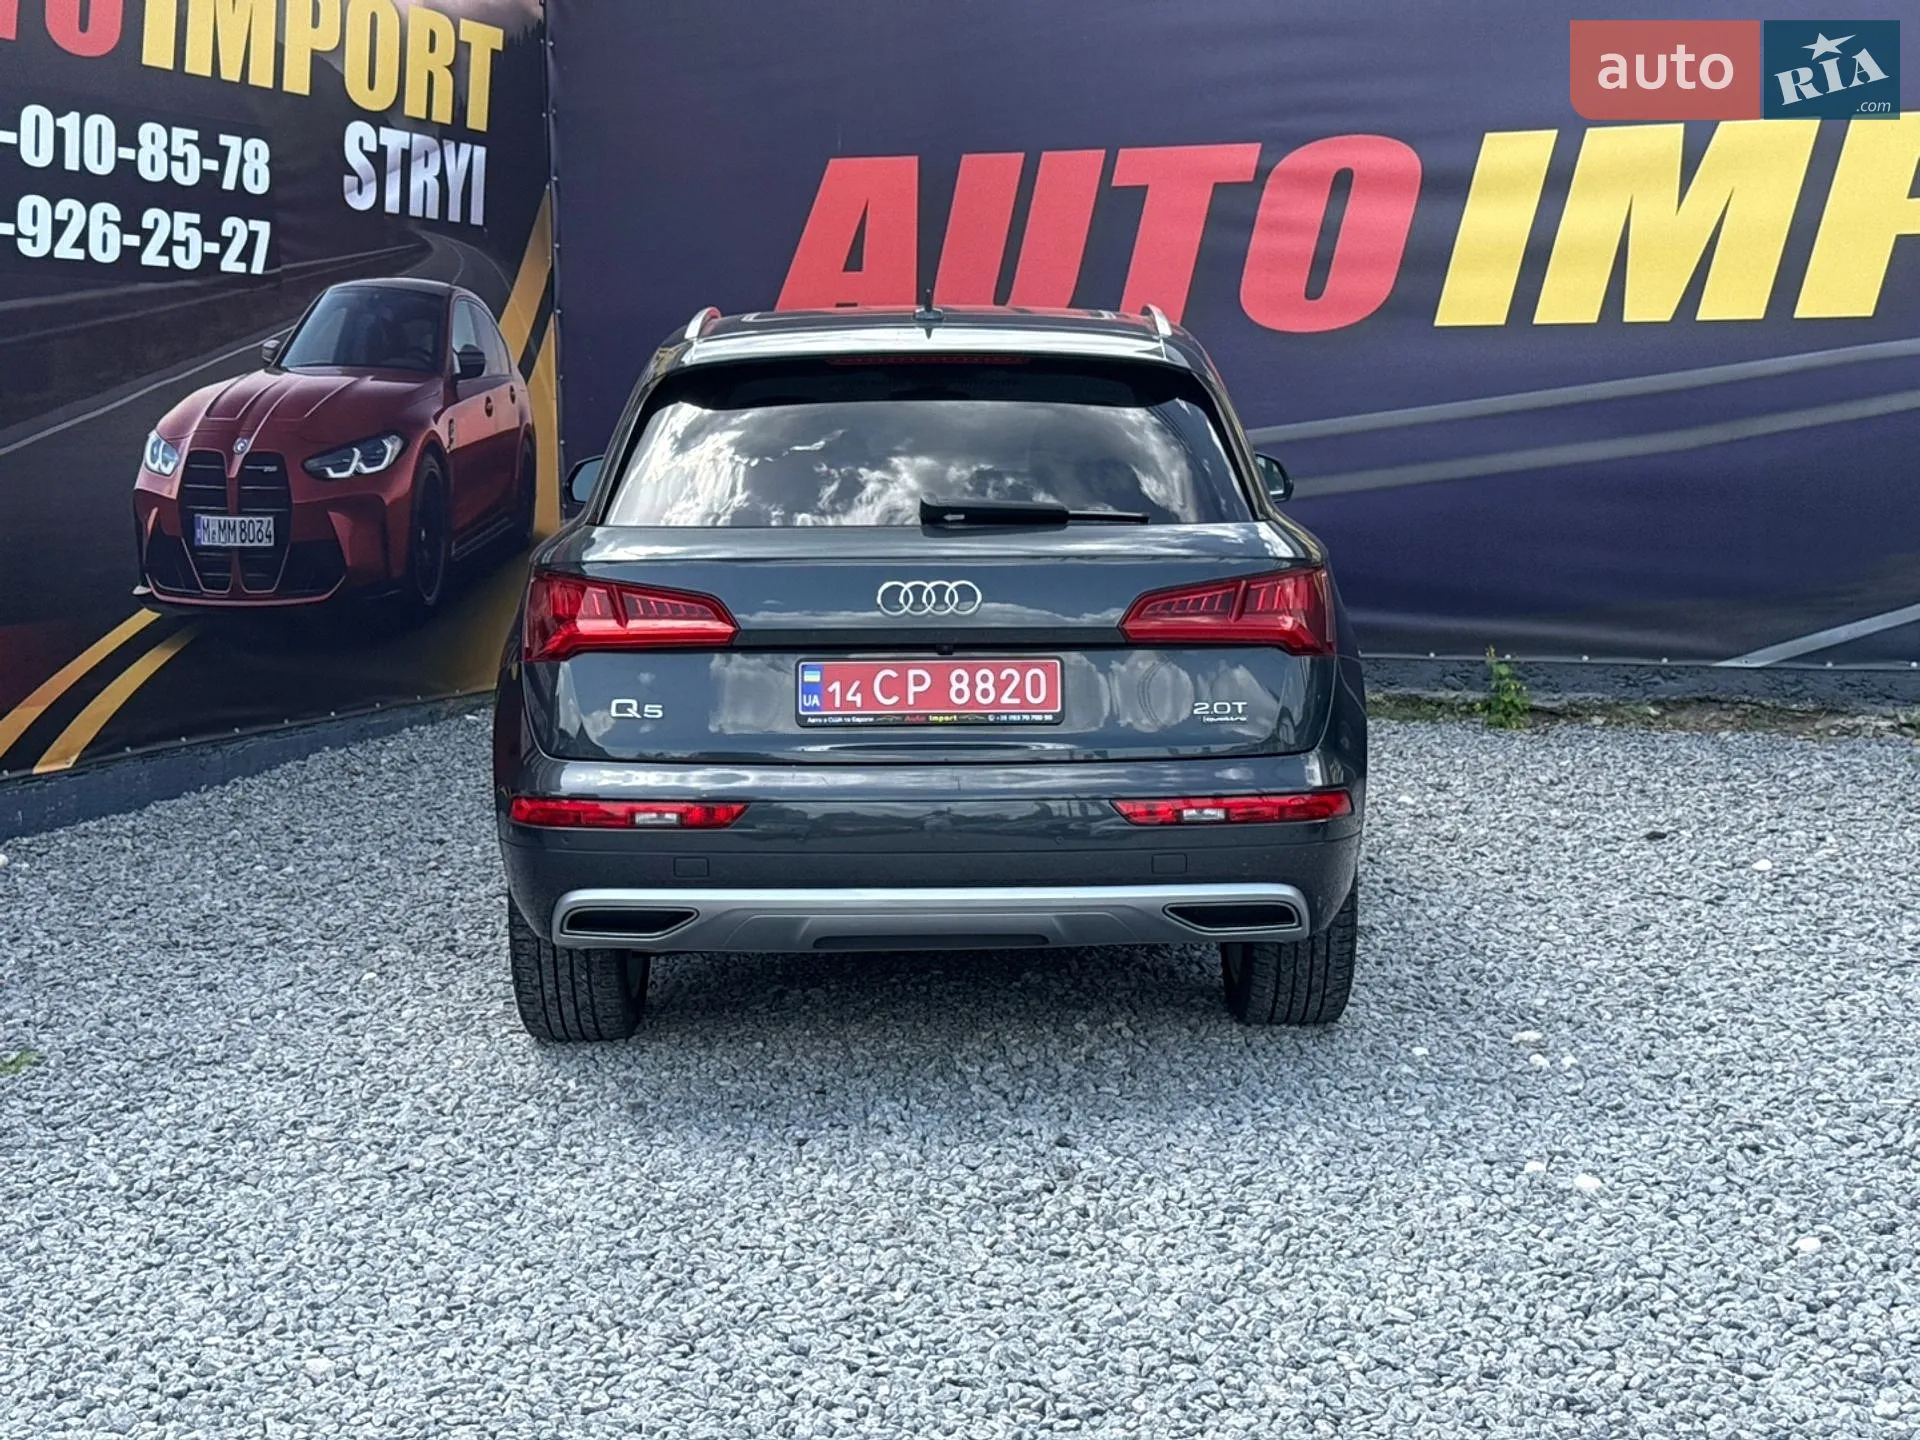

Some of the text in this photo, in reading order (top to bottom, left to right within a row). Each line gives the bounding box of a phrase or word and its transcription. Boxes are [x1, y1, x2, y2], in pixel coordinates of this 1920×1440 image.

[141, 0, 504, 132] IMPORT
[343, 120, 487, 226] STRYI
[774, 133, 1422, 333] AUTO
[802, 667, 1048, 708] UA 14 CP 8820
[1192, 701, 1248, 715] 2.0T
[610, 698, 664, 719] Q5
[928, 714, 958, 723] Import
